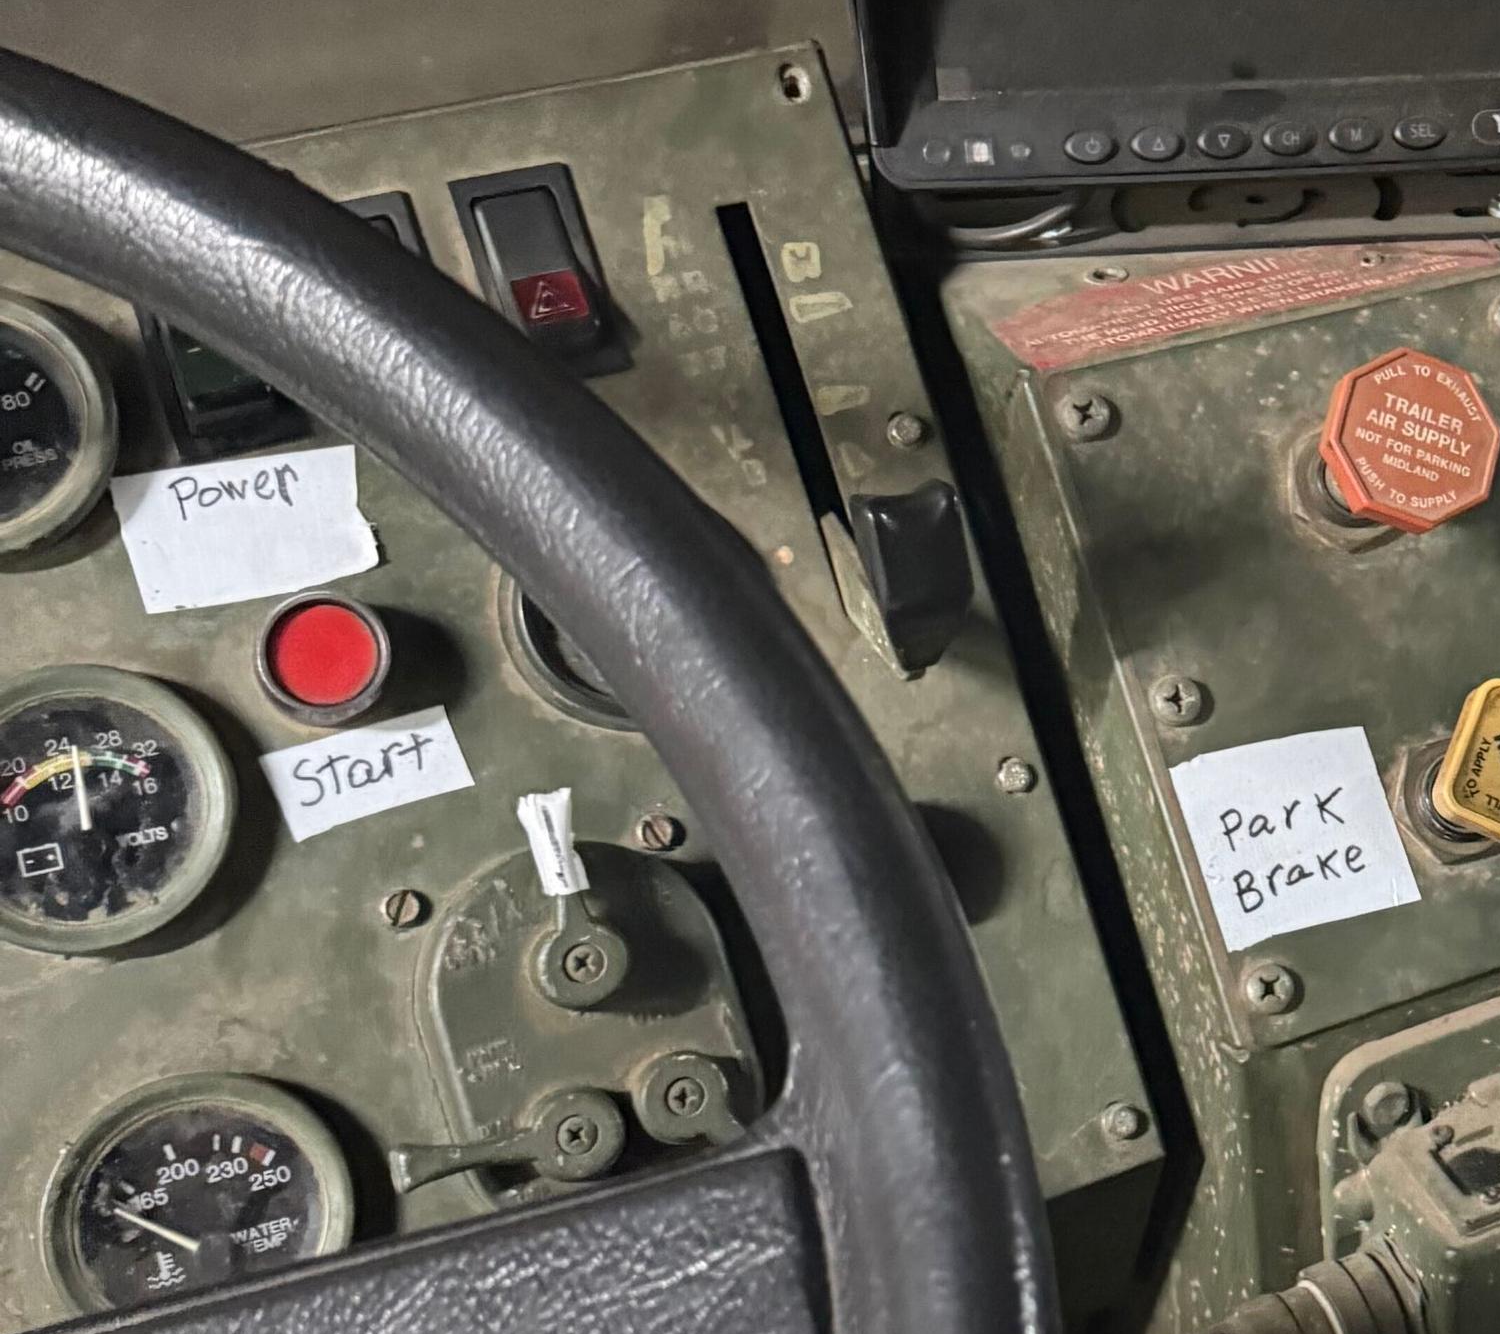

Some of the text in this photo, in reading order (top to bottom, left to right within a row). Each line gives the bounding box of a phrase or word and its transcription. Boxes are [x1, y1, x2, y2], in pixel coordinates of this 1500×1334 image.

[1409, 123, 1437, 139] SEL
[1, 391, 31, 411] 80
[1373, 364, 1482, 422] PULL TO EXHAUST
[1385, 392, 1464, 436] TRAILER
[1365, 408, 1472, 458] AIR SUPPLY
[1354, 427, 1472, 478] NOT FOR PARKING
[1382, 453, 1440, 483] MIDLAND
[168, 463, 298, 520] Power
[1355, 456, 1458, 508] PUSH TO SUPPLY
[44, 736, 71, 758] 24
[94, 730, 123, 750] 28
[131, 739, 161, 759] 32
[99, 770, 123, 789] 14
[292, 732, 434, 807] Start
[1464, 778, 1481, 800] TO
[1474, 737, 1493, 777] APPLY
[48, 773, 74, 792] 12
[131, 777, 159, 796] 16
[2, 804, 30, 824] 10
[156, 1158, 200, 1186] 200
[206, 1157, 249, 1184] 230
[249, 1165, 292, 1192] 250
[230, 1217, 293, 1245] WATER
